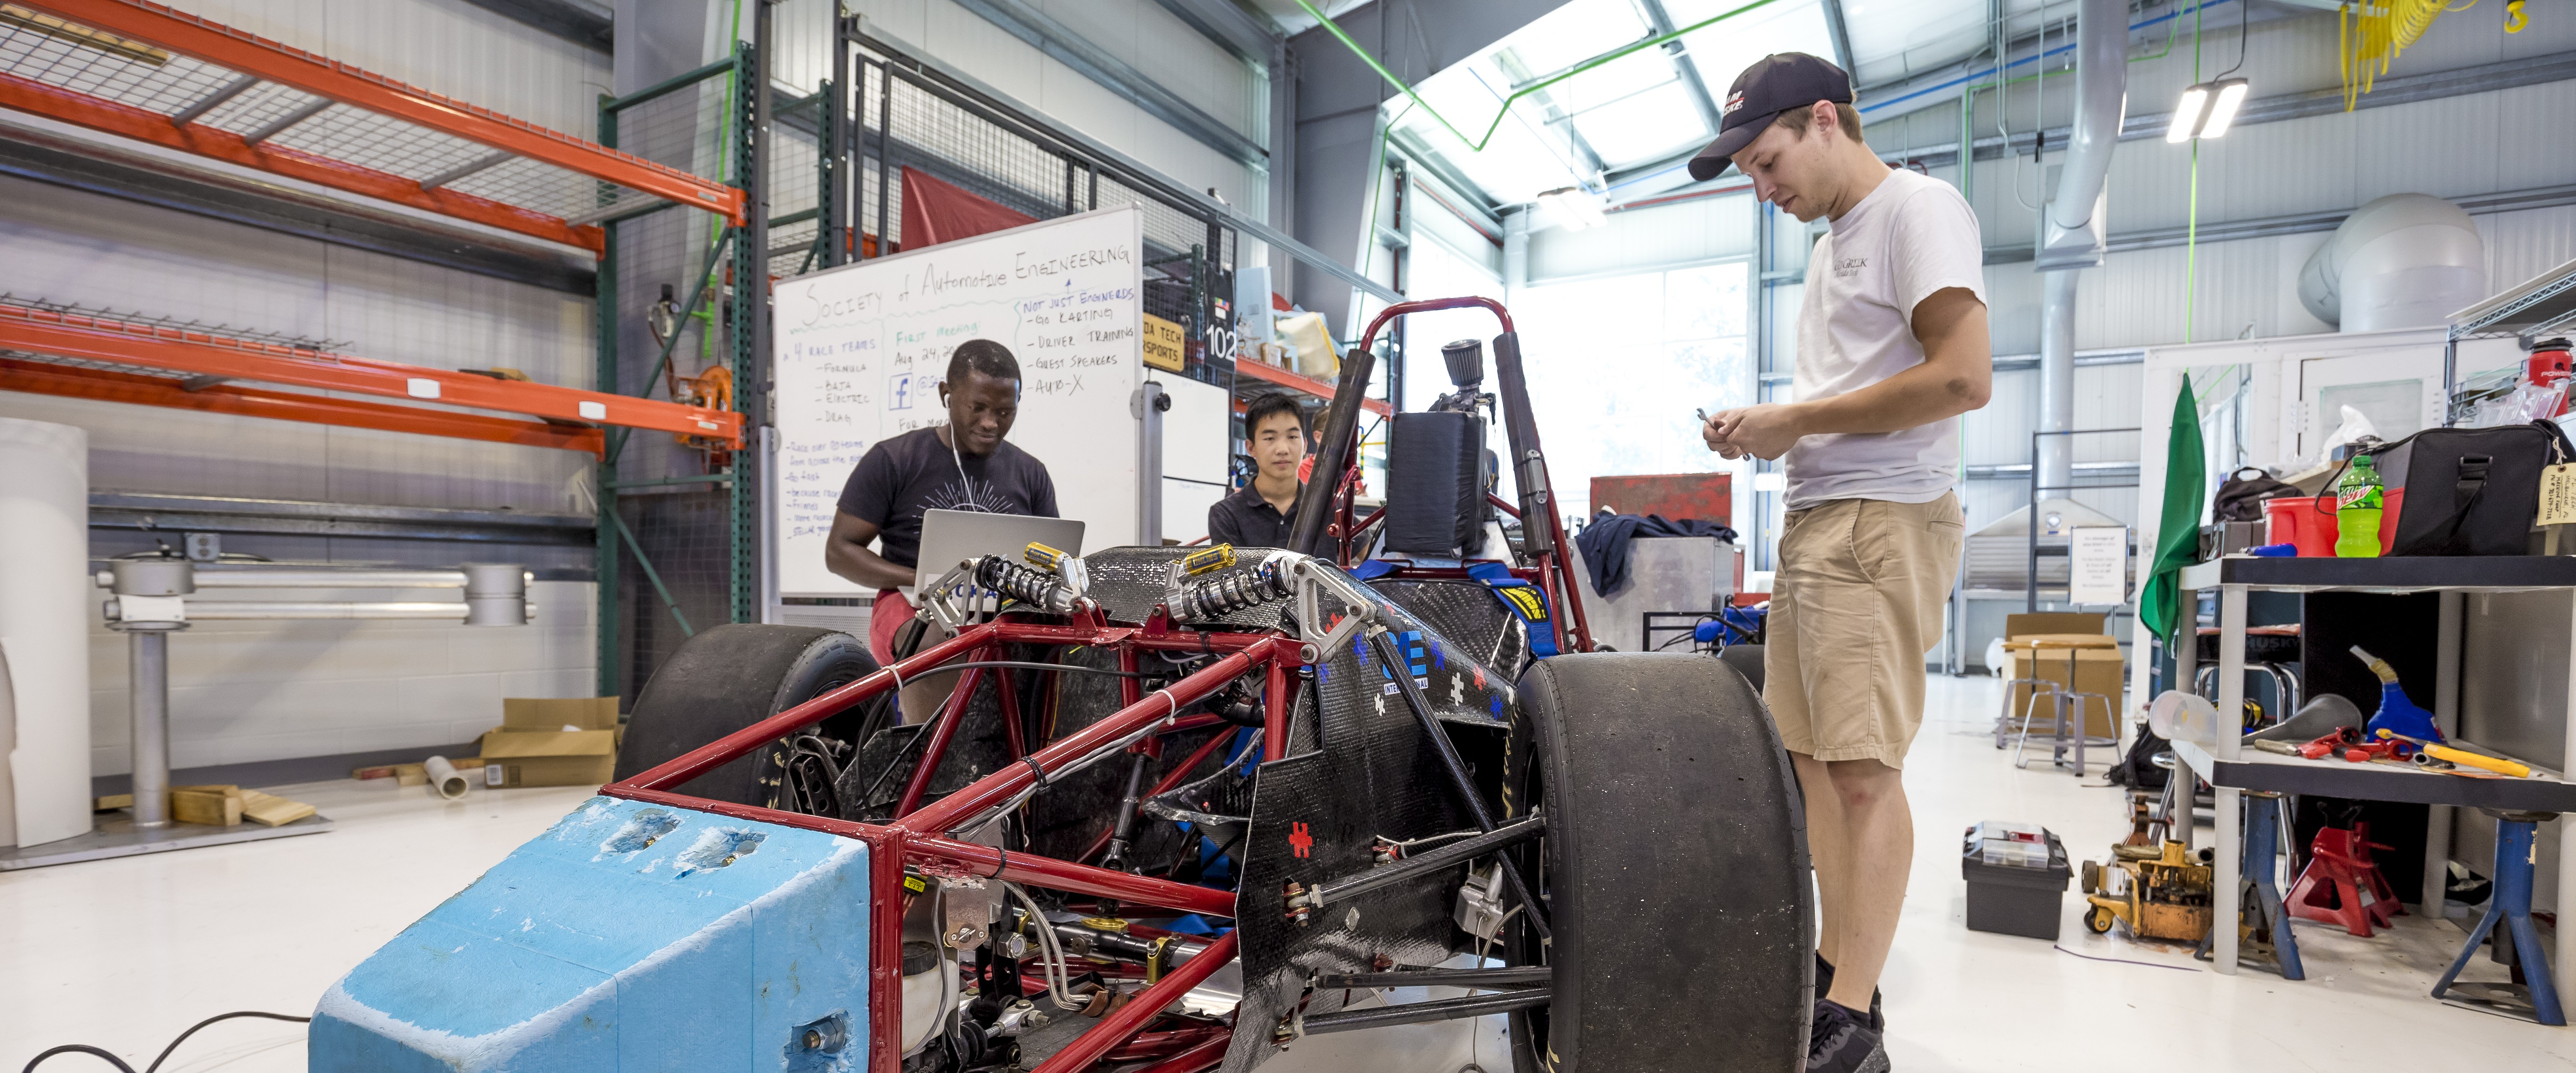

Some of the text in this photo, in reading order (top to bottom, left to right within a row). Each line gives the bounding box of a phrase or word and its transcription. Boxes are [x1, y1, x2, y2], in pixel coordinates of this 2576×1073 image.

[802, 283, 882, 326] SOCIETY
[899, 274, 910, 302] of
[1023, 301, 1045, 314] NOT
[1049, 296, 1075, 309] JUST
[1060, 307, 1113, 323] KARTING
[1087, 326, 1134, 342] TRAINING
[1160, 327, 1181, 344] TECH
[1206, 324, 1236, 362] 102
[808, 345, 833, 357] RACE
[841, 339, 876, 353] TEAMS
[894, 352, 912, 371] Aug
[942, 345, 958, 357] 20
[1070, 355, 1118, 368] SPEAKERS
